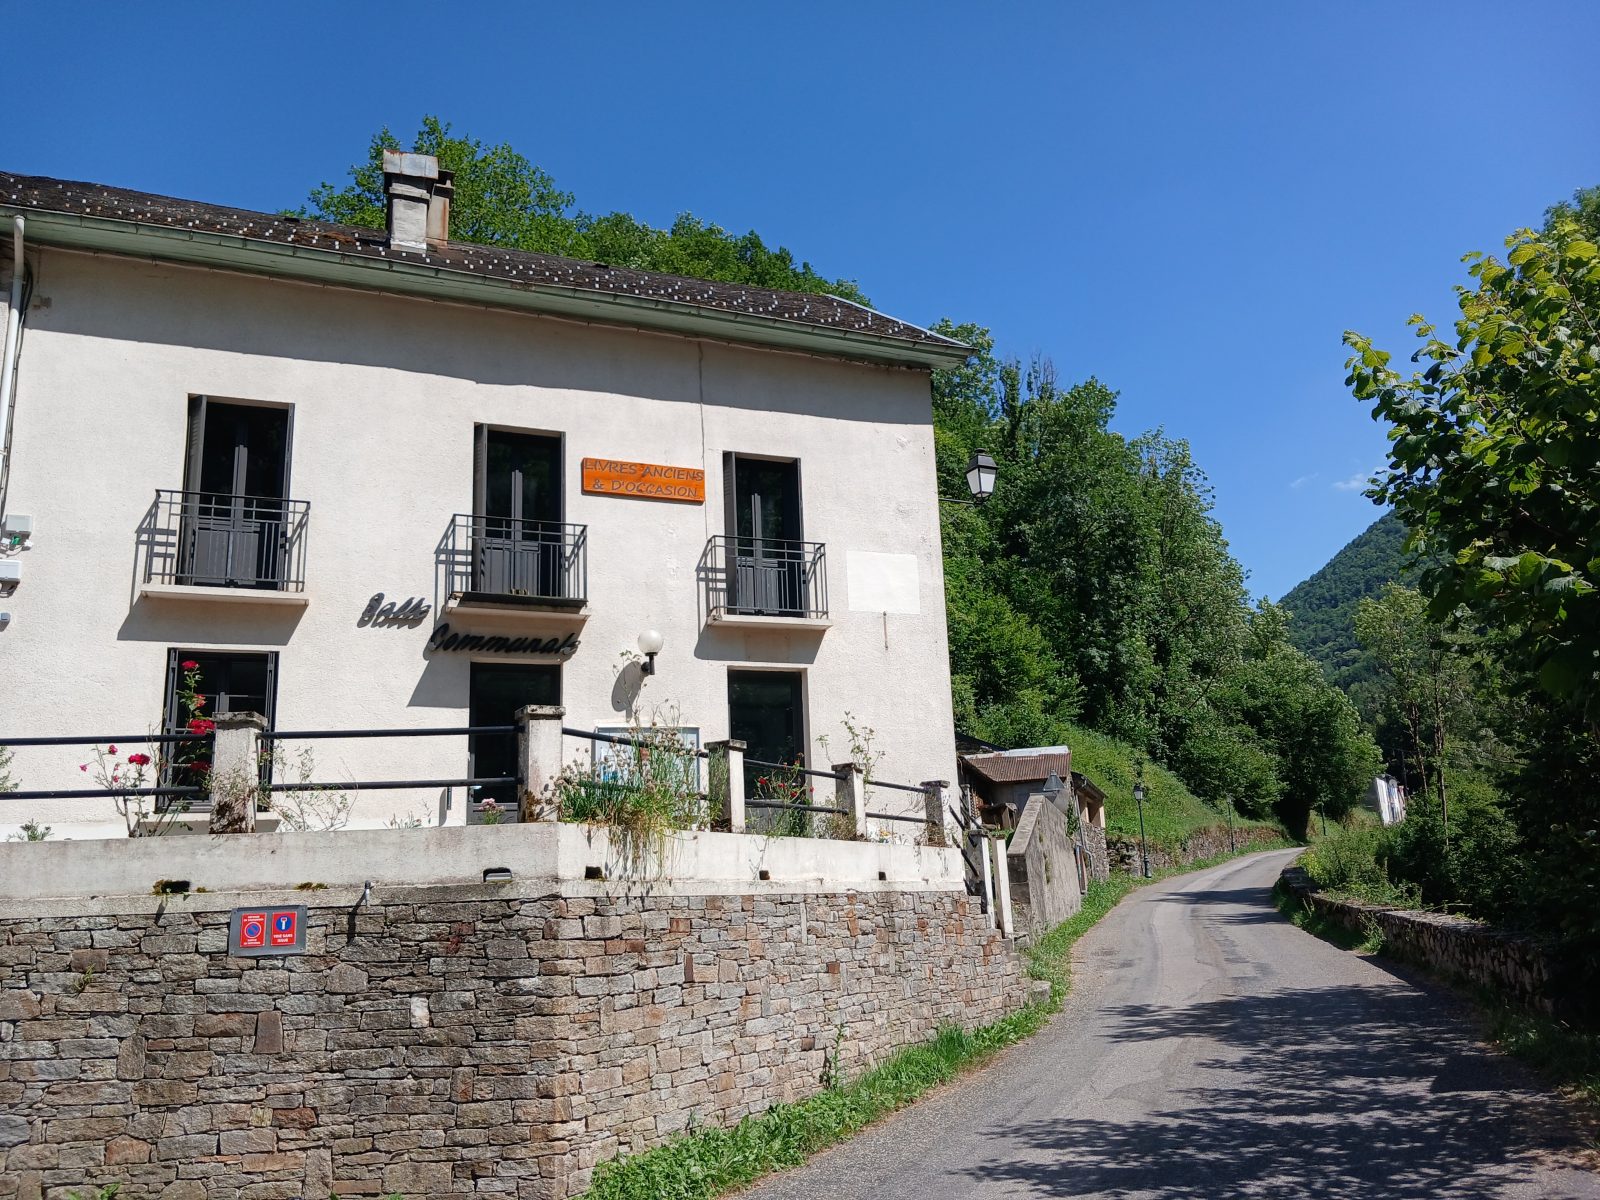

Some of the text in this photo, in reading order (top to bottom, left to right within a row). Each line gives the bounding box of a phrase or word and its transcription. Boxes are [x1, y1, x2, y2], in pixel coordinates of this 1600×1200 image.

[585, 460, 705, 481] LIVRES ANCIENS
[592, 479, 697, 497] & D'OCCASION
[430, 623, 581, 655] Communale
